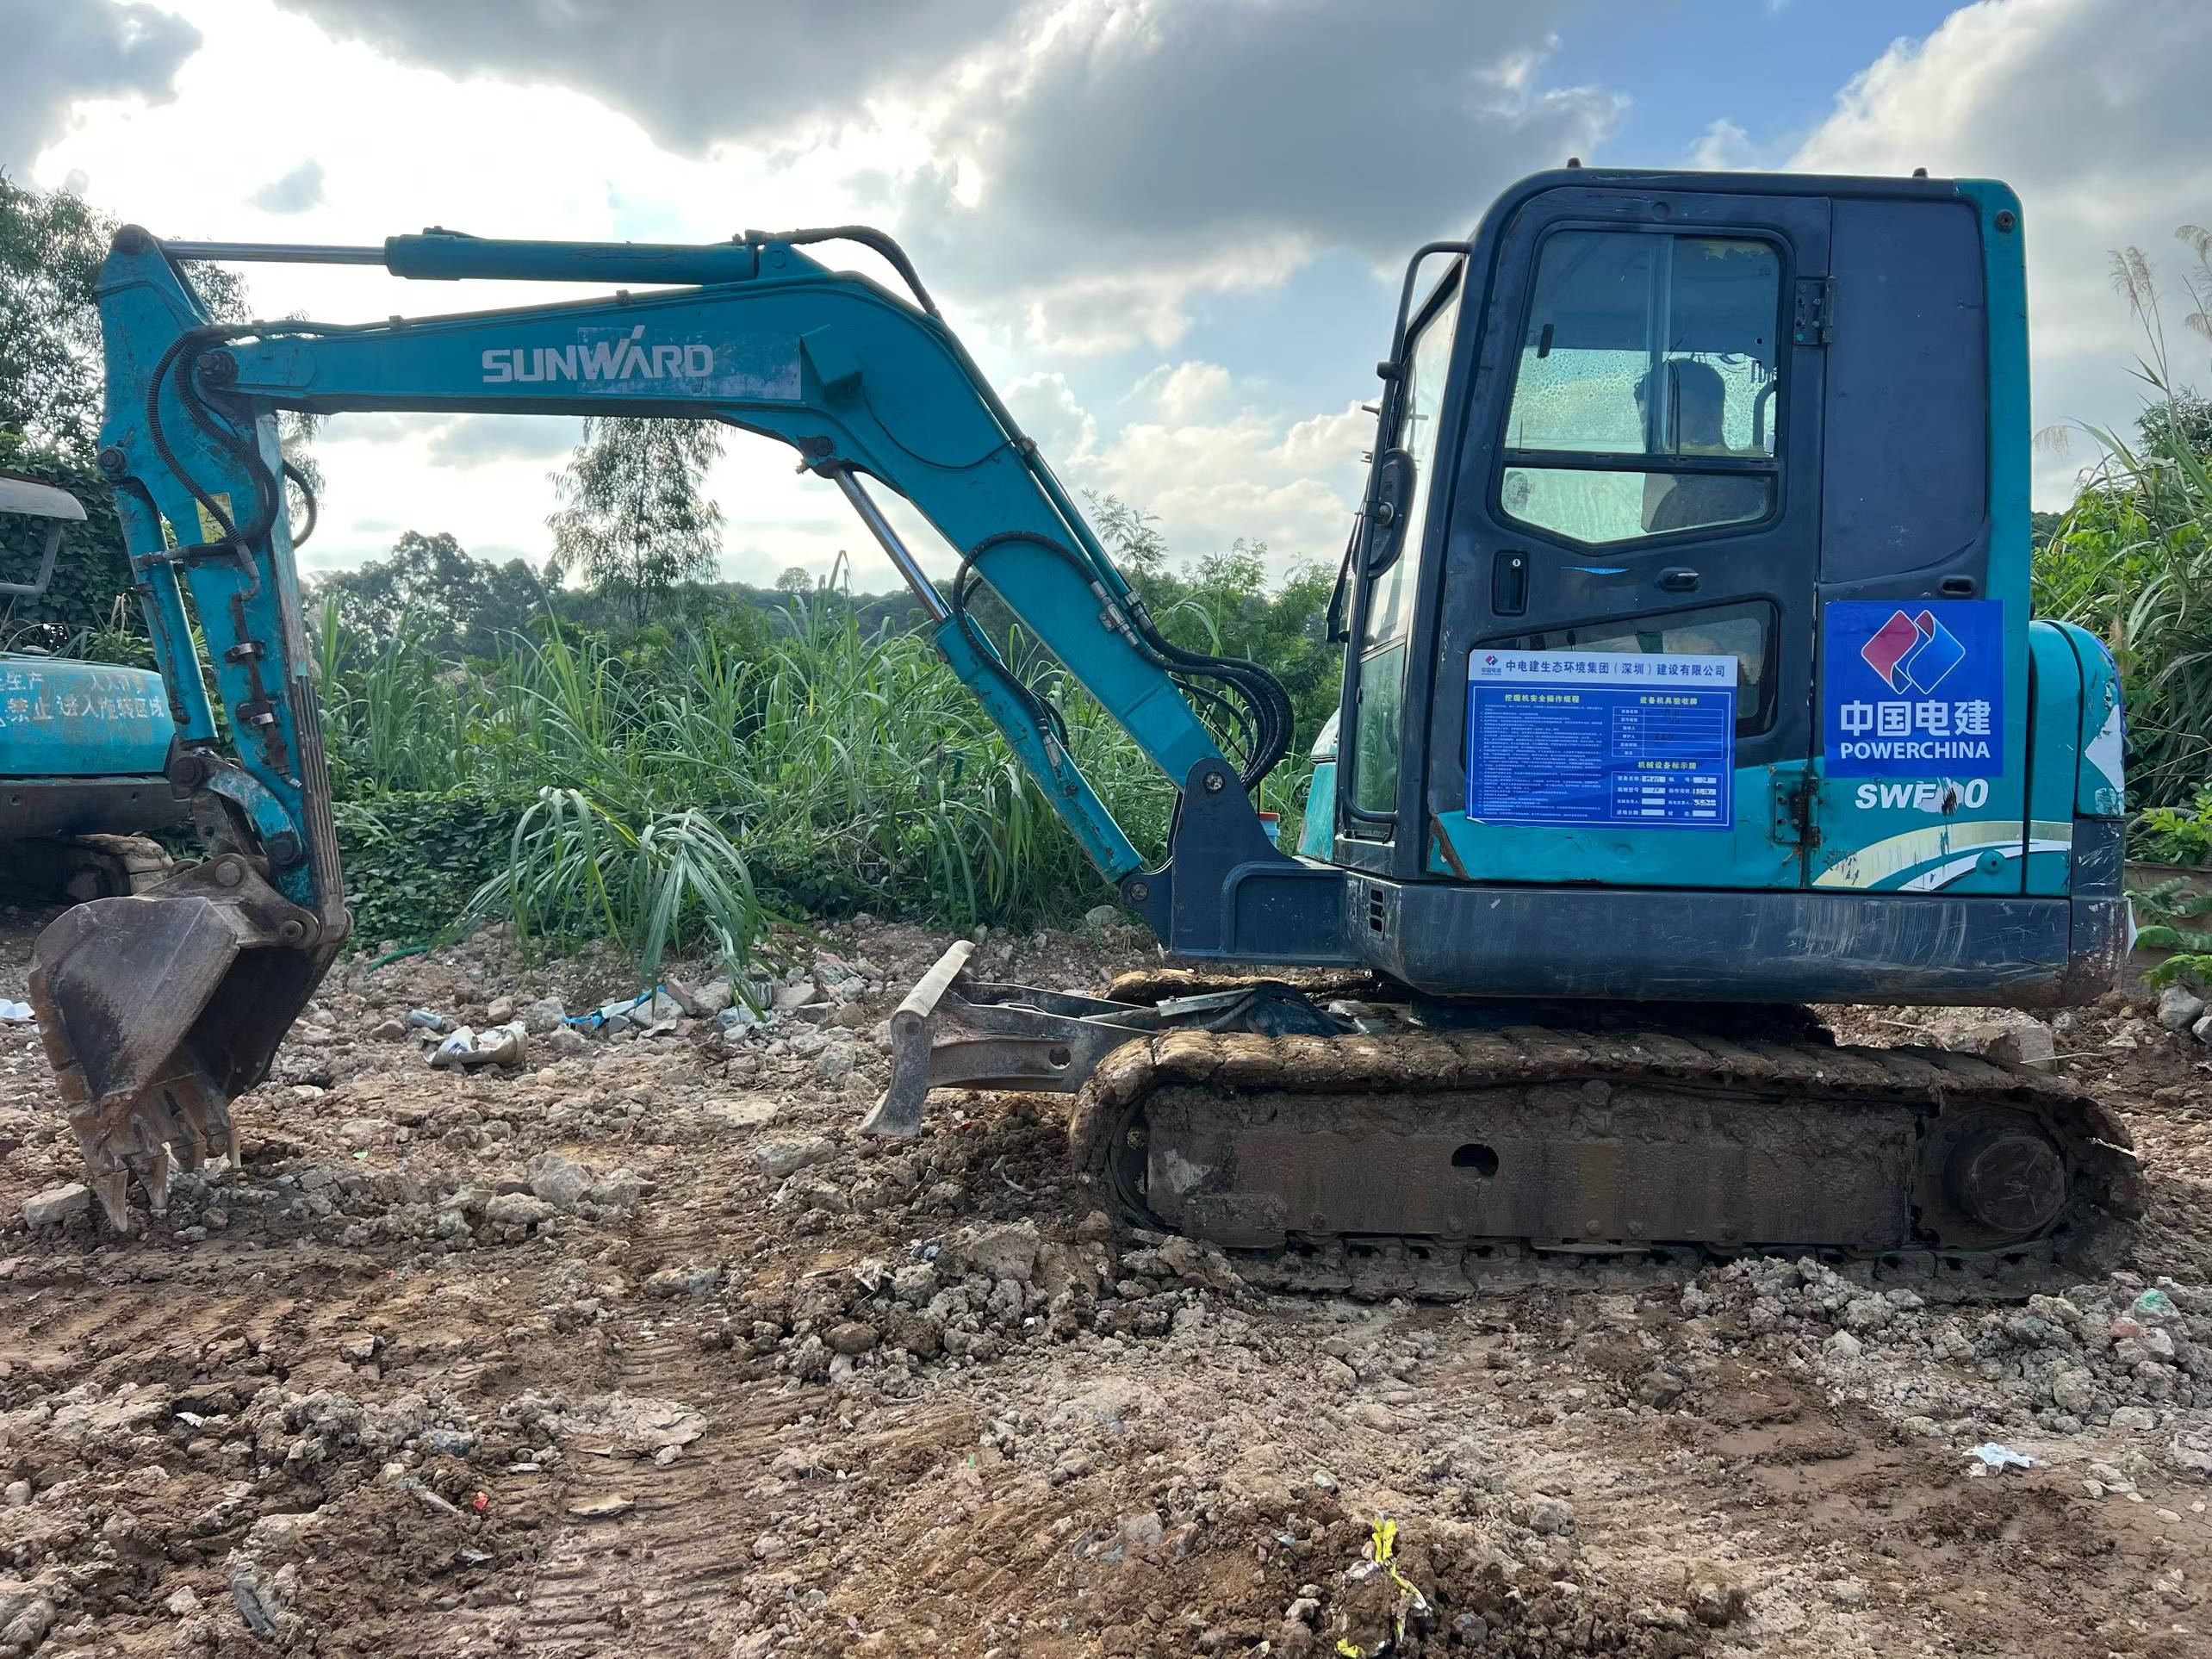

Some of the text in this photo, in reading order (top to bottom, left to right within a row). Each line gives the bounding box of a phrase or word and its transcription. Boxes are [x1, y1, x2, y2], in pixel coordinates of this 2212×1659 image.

[482, 325, 713, 382] SUNWARD
[1506, 659, 1725, 677] 中电建生态环境集团（深圳）建设有限公司
[1505, 693, 1580, 704] 挖掘机安全操作规程
[1840, 699, 1991, 736] 中国电建
[1840, 741, 1991, 759] POWERCHINA
[1855, 778, 1989, 810] SWE0
